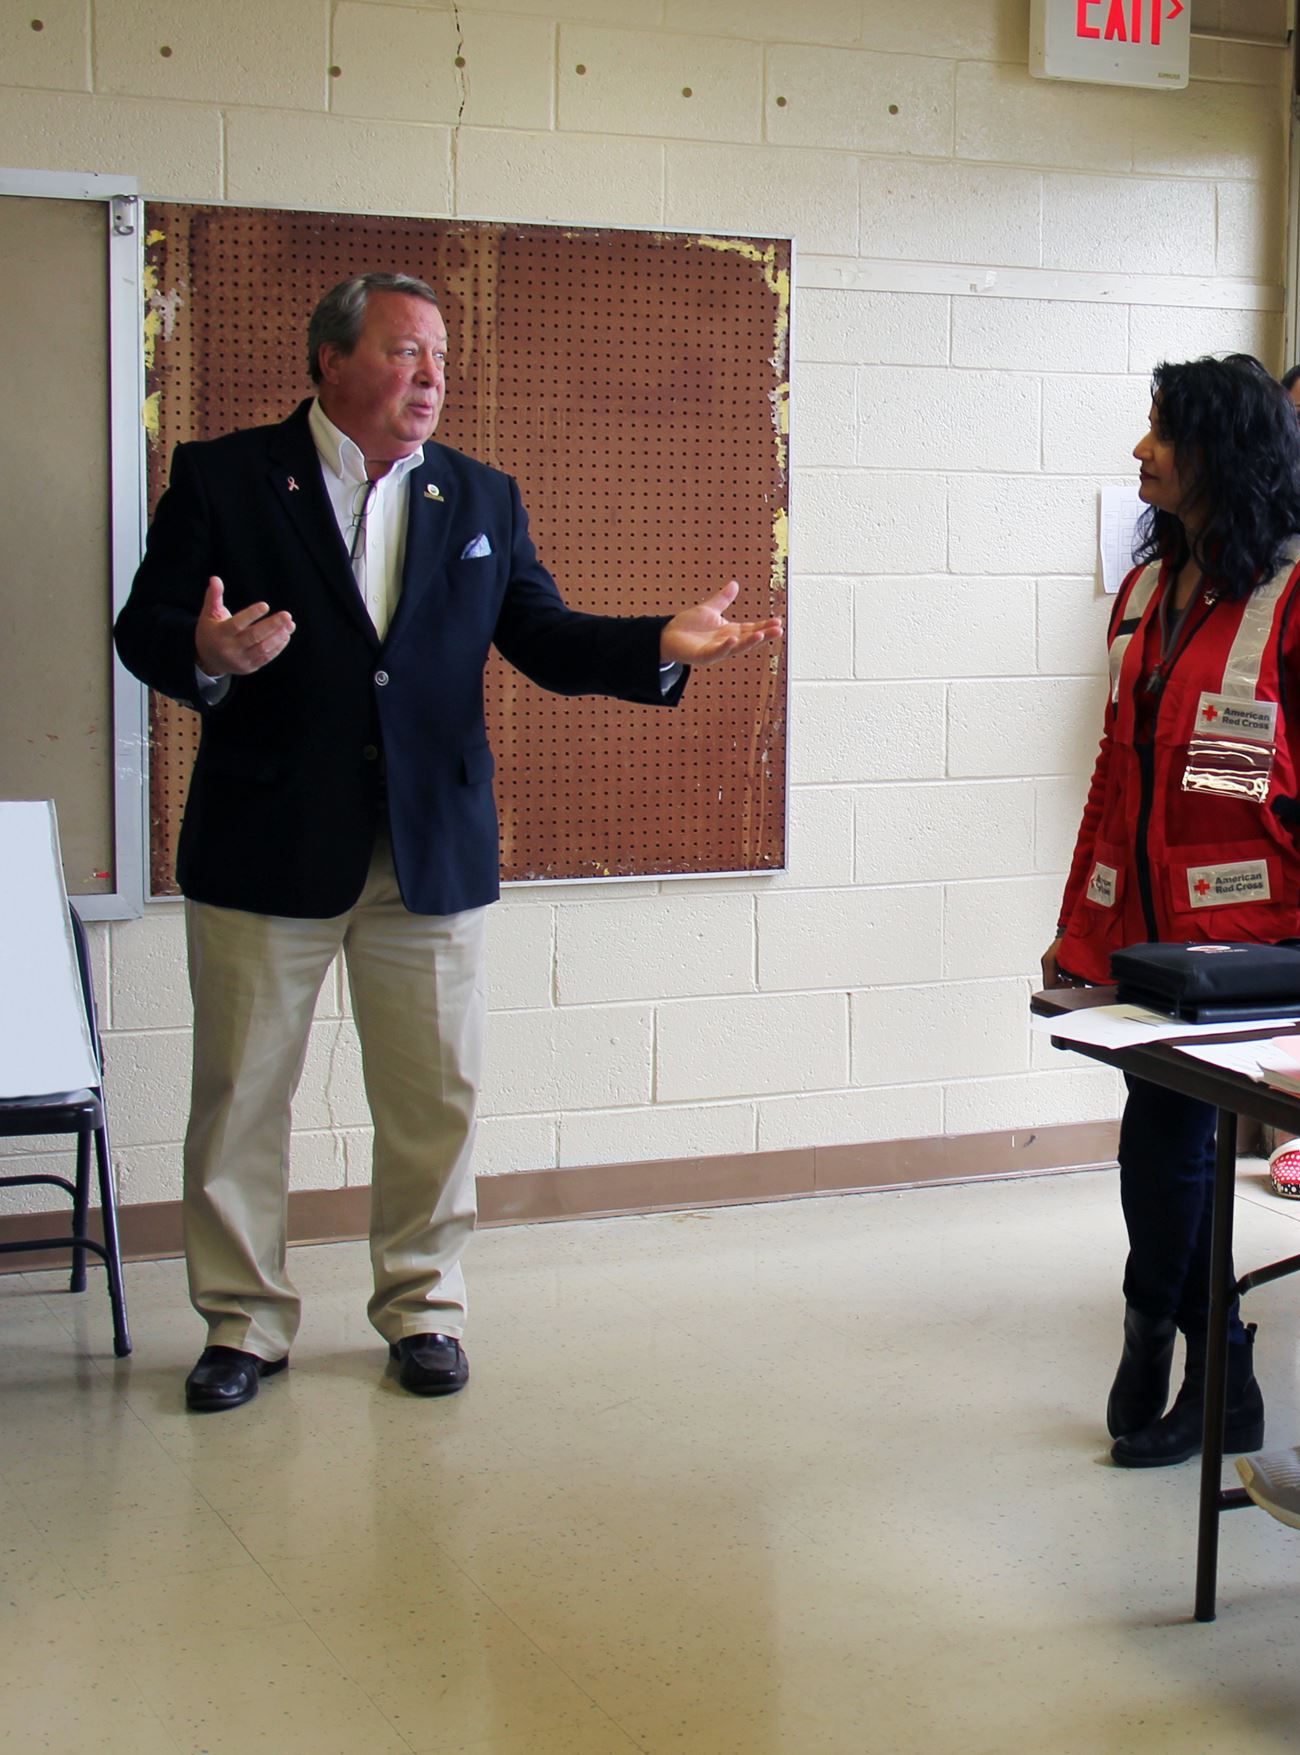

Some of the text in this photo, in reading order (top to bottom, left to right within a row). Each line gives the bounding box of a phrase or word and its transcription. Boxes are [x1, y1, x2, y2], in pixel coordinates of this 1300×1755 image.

[1223, 707, 1270, 721] American
[1222, 716, 1269, 730] Red Cross
[1215, 873, 1262, 885] American
[1216, 882, 1264, 894] Red Cross
